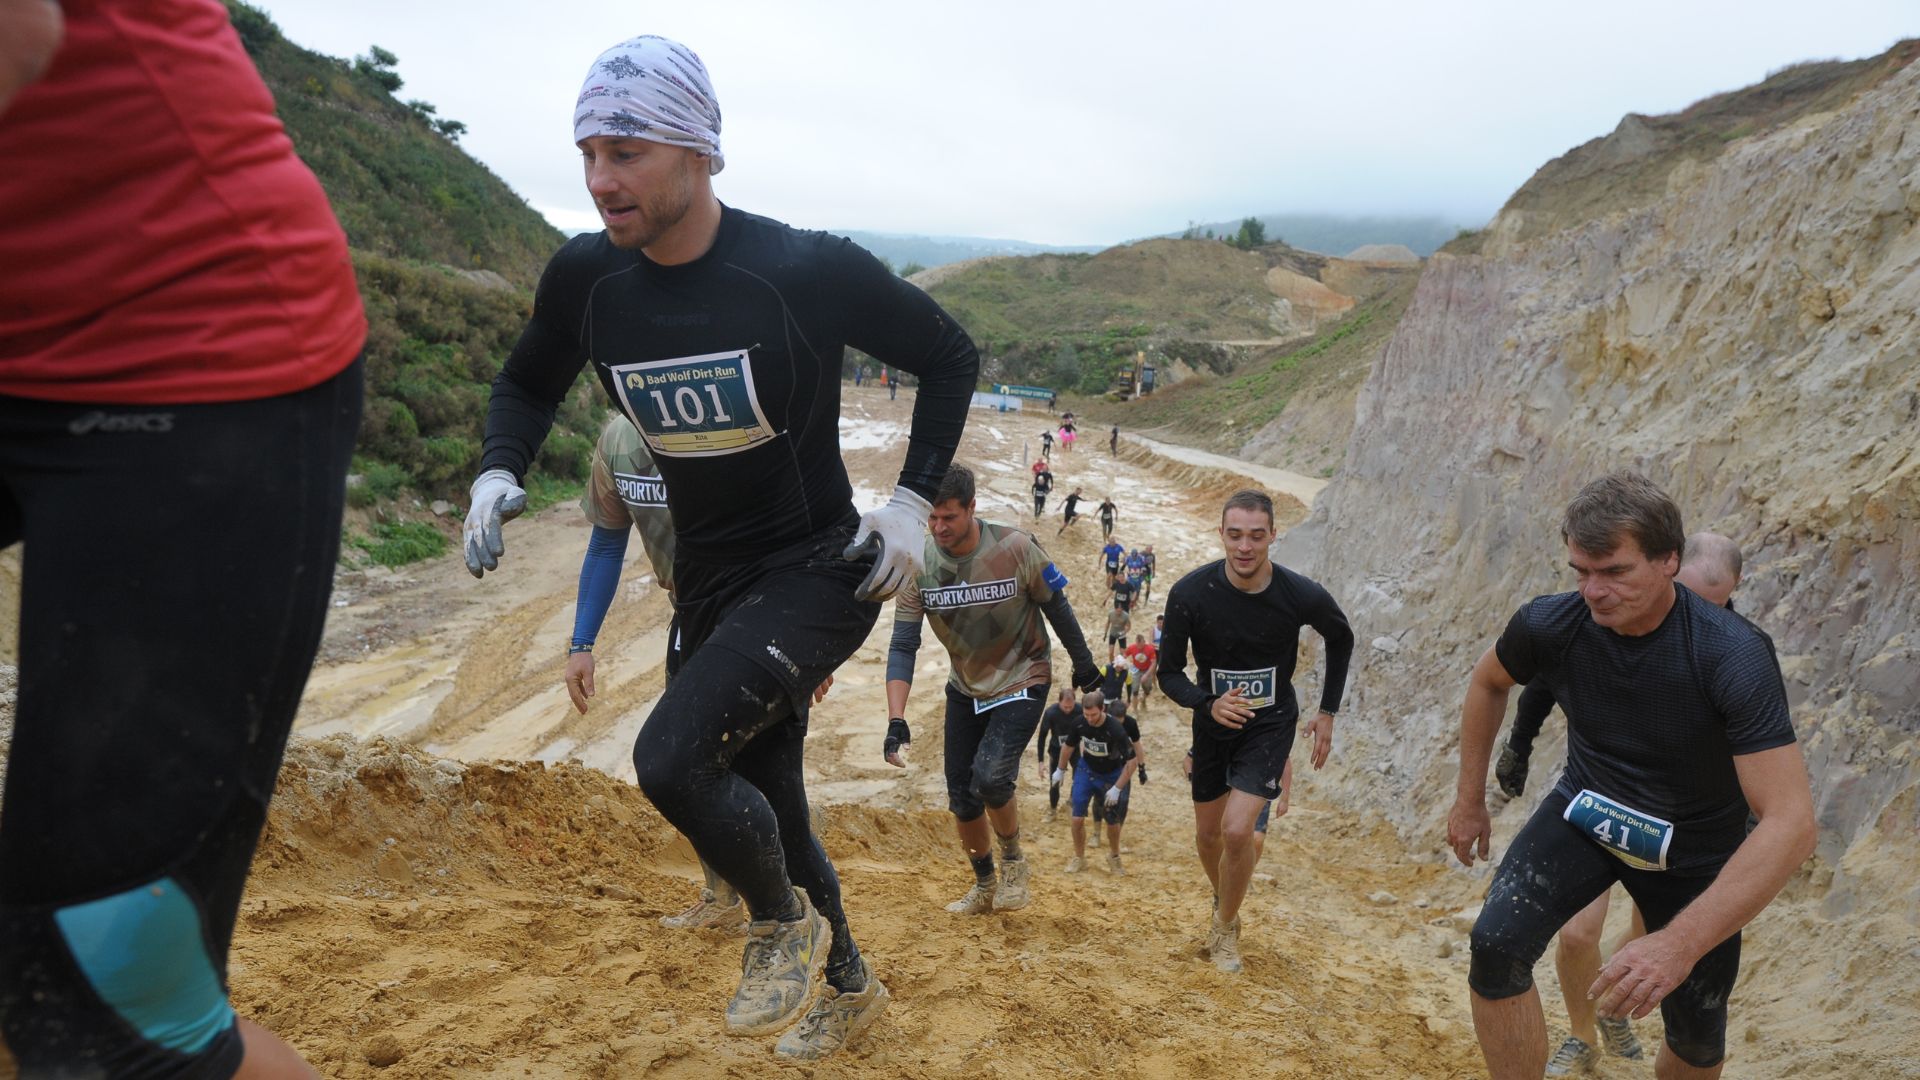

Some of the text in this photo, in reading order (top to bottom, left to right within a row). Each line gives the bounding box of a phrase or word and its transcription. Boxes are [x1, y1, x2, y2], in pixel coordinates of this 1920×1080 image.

[646, 373, 667, 385] Bad
[667, 370, 691, 382] Wolf
[693, 368, 713, 380] Dirt
[714, 367, 736, 377] Run
[650, 384, 731, 427] 101
[1593, 802, 1608, 814] Bad
[1608, 808, 1626, 821] Wolf
[1627, 816, 1643, 830] Dirt
[1643, 823, 1661, 836] Run
[1593, 818, 1630, 851] 41
